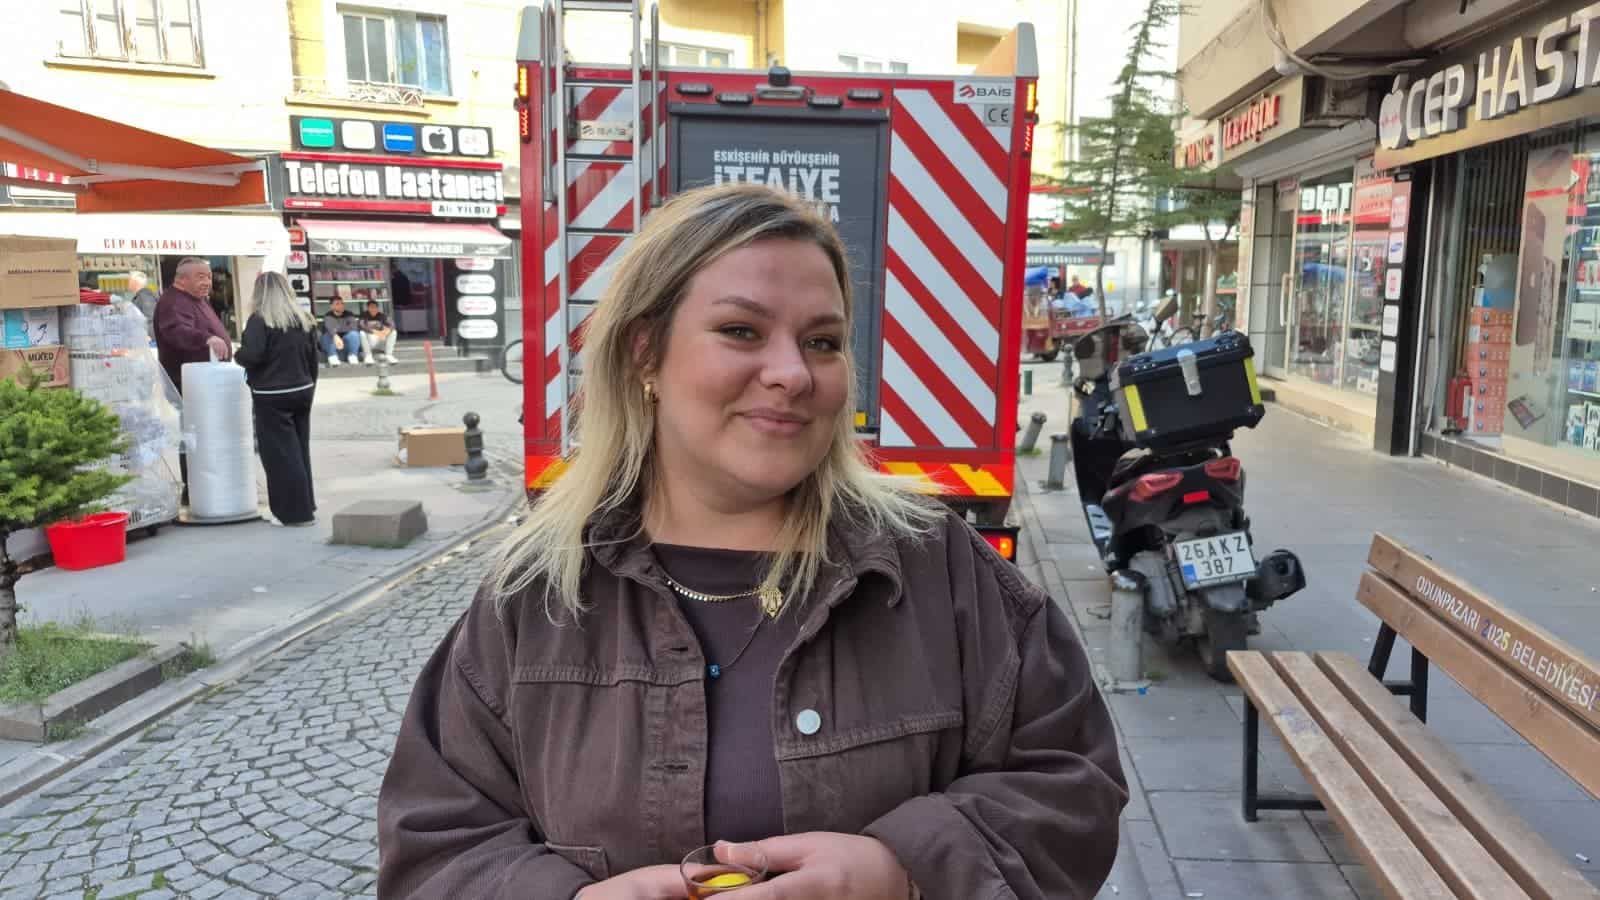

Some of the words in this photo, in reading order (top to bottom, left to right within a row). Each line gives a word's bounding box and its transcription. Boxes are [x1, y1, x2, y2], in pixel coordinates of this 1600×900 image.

[1406, 64, 1470, 142] CEP
[1475, 0, 1600, 121] HAST
[714, 148, 770, 166] ESKİŞEHİR
[772, 150, 840, 168] BÜYÜKŞEHİR
[285, 161, 381, 196] Telefon
[384, 166, 504, 201] Hastanesi
[347, 240, 400, 253] TELEFON
[28, 352, 54, 362] MIXED
[1201, 556, 1233, 577] 387
[1416, 575, 1481, 632] ODUNPAZARI
